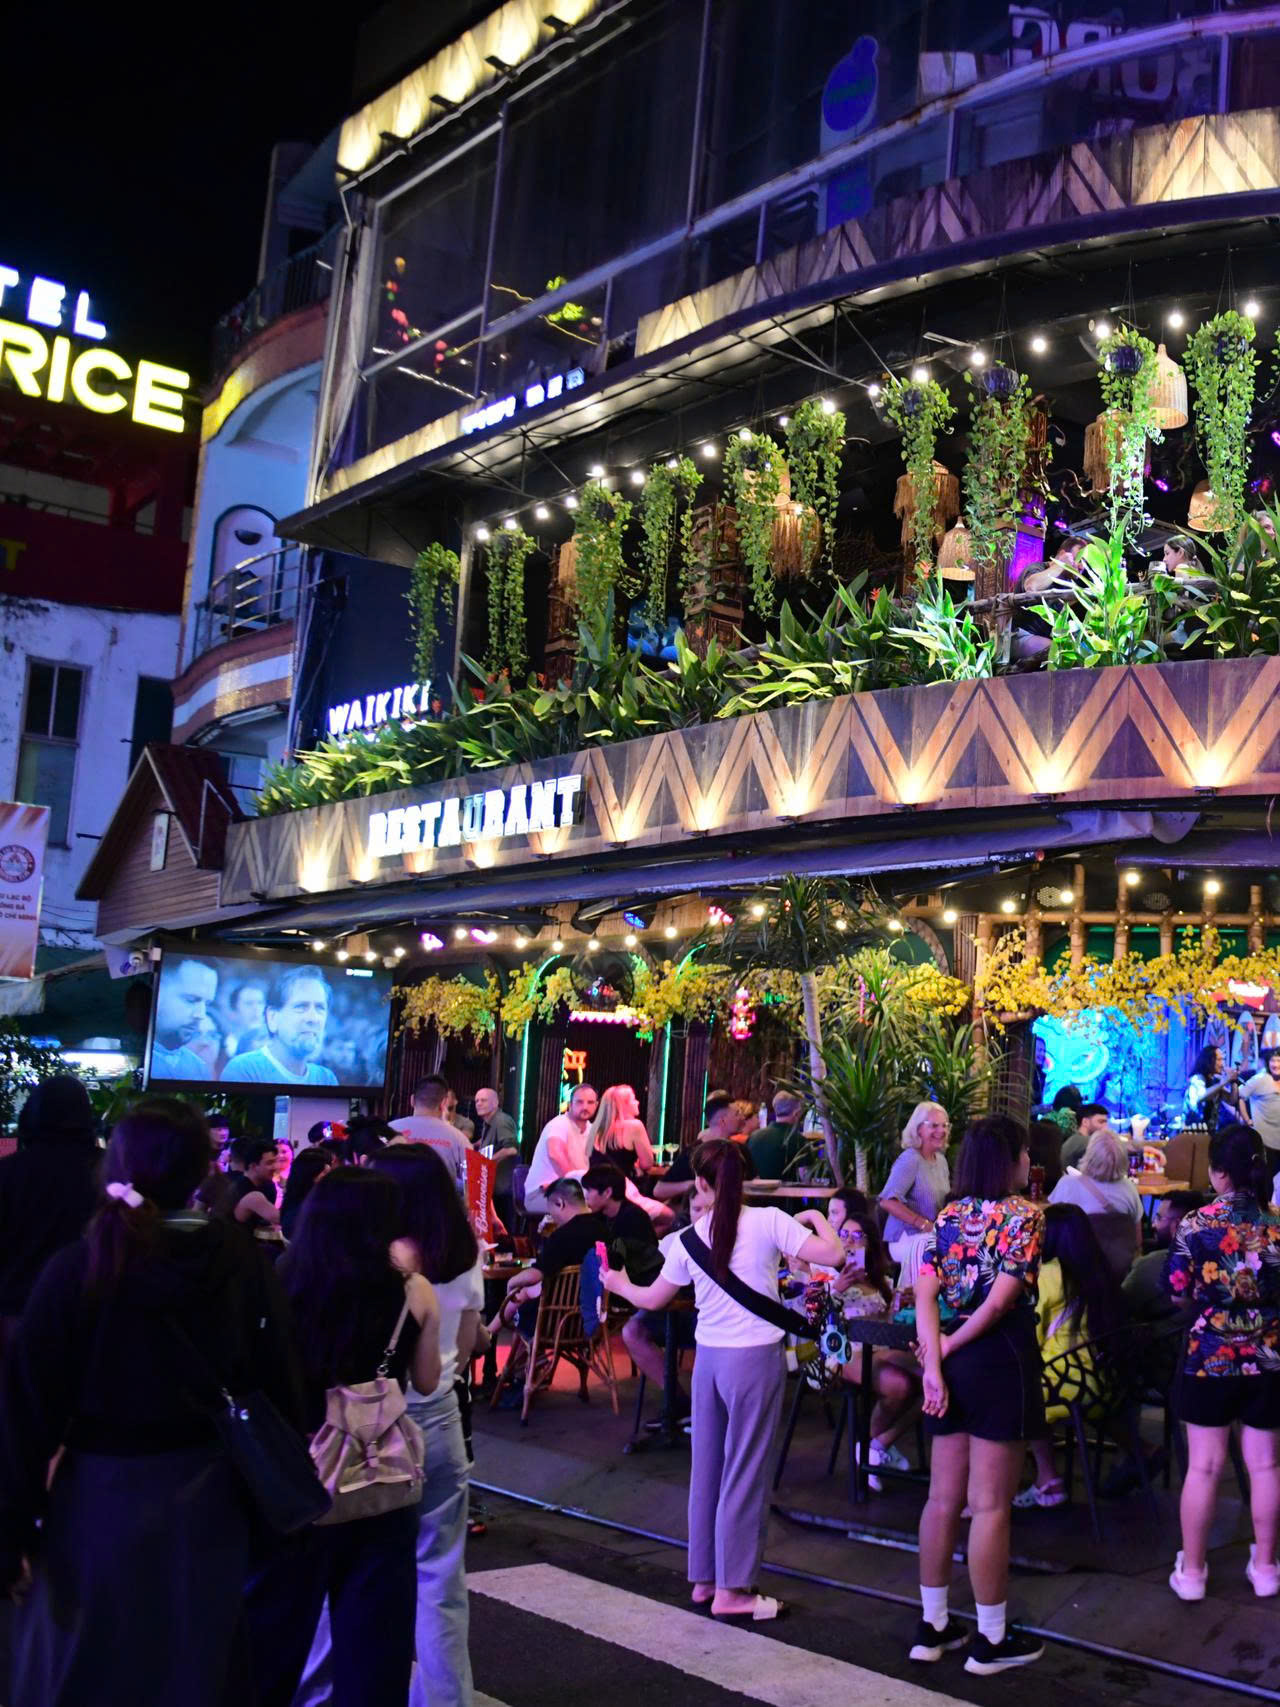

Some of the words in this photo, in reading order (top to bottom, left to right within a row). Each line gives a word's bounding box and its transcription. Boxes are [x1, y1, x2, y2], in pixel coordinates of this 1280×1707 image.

[0, 264, 107, 340] TEL
[0, 318, 190, 433] RICE
[328, 678, 432, 736] WAIKIKI
[368, 774, 582, 859] RESTAURANT
[474, 1164, 489, 1233] Budweiser
